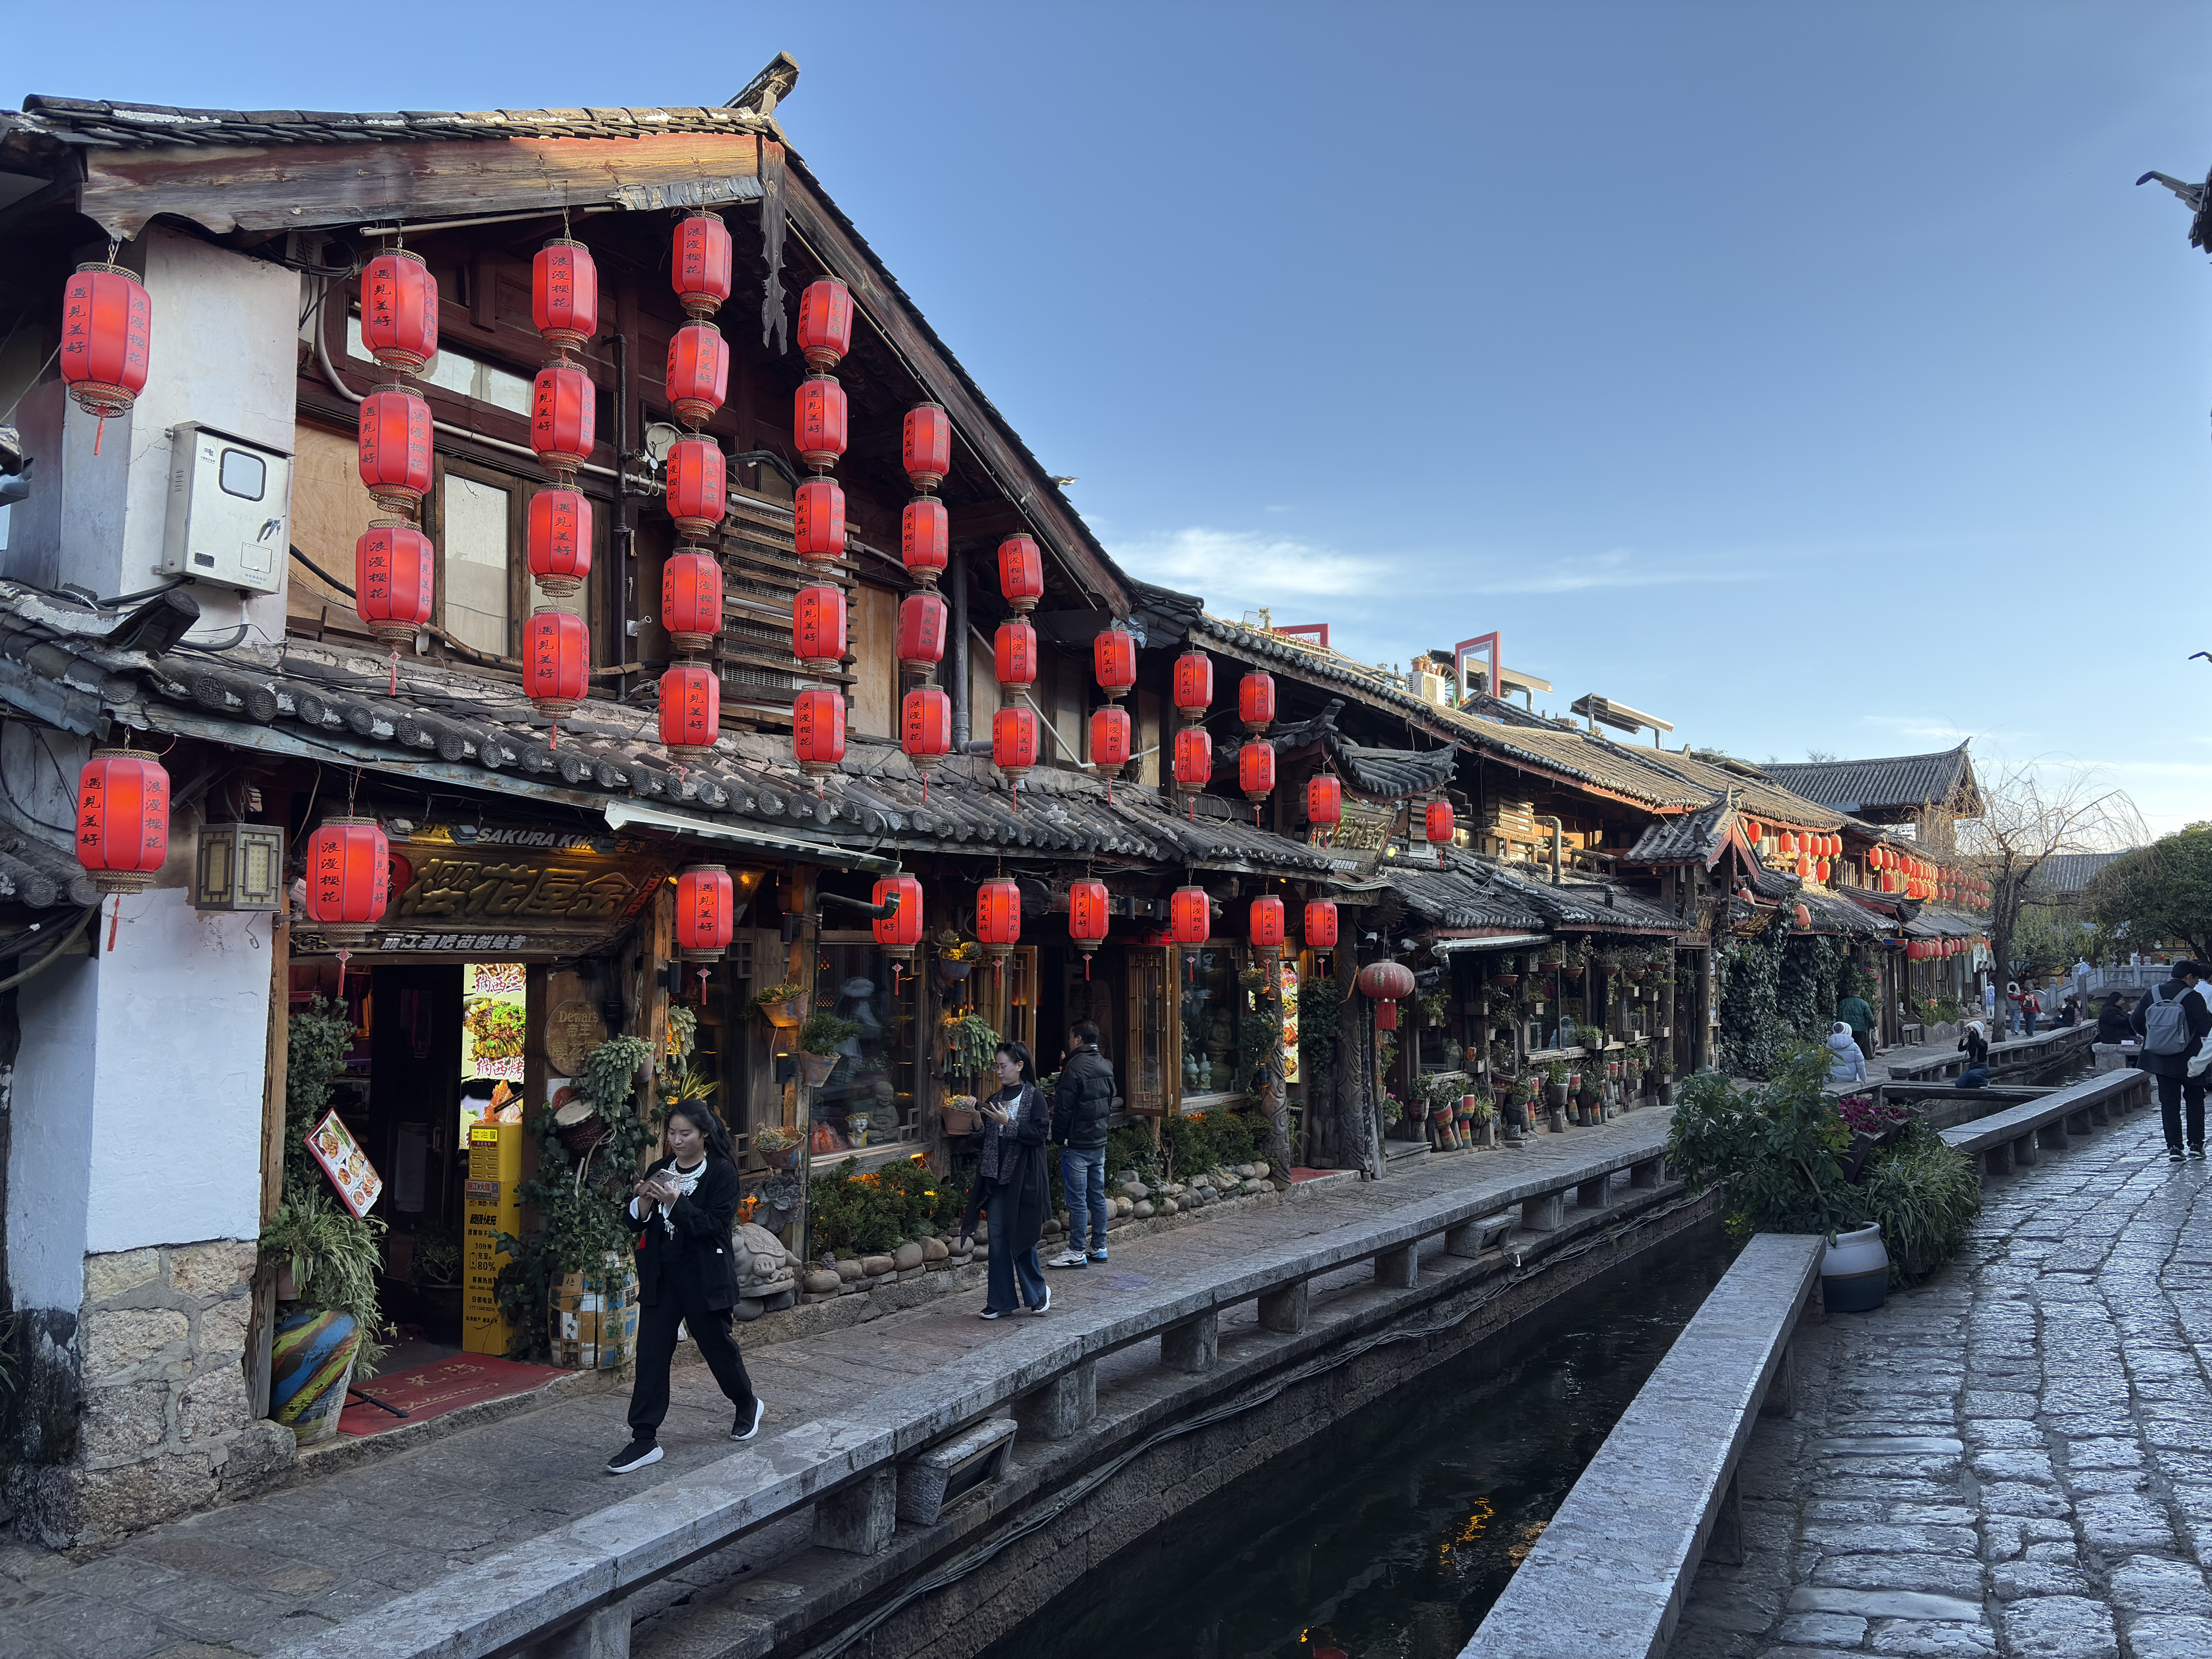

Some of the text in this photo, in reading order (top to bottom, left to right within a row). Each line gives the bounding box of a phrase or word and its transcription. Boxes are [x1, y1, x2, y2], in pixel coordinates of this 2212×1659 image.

[476, 827, 556, 847] SAKURA
[380, 933, 526, 950] 丽江酒吧街创始者
[476, 975, 525, 993] 纳西三
[557, 1010, 599, 1023] Dewar's
[478, 1262, 496, 1271] 80%
